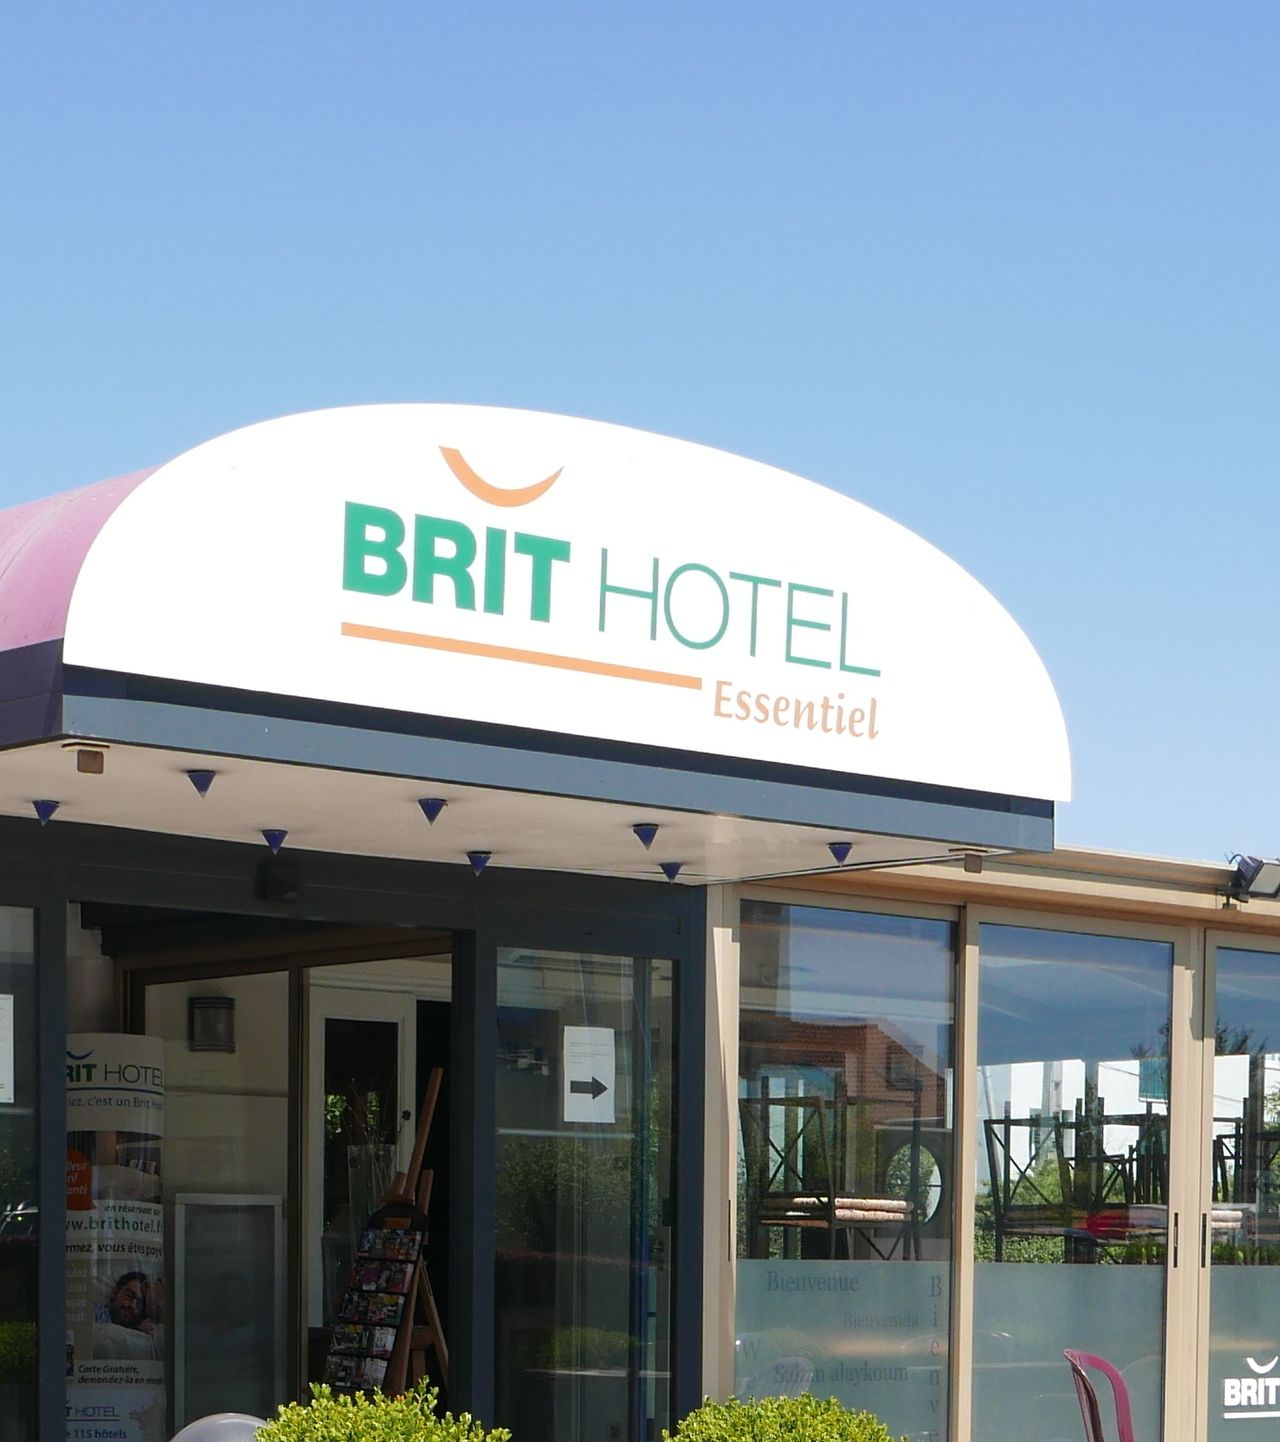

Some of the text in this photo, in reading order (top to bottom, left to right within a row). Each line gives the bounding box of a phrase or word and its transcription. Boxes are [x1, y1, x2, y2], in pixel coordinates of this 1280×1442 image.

[342, 501, 881, 678] BRIT HOTEL
[714, 680, 879, 740] Essentiel
[65, 1064, 97, 1082] RIT
[87, 1095, 113, 1107] c'est
[116, 1098, 130, 1107] un
[65, 1243, 94, 1254] rmez,
[98, 1244, 125, 1253] vous
[767, 1270, 859, 1292] Bienvenue
[842, 1310, 920, 1329] Bienvenida
[78, 1364, 101, 1374] Carte
[831, 1361, 908, 1386] alaykoum
[1224, 1378, 1280, 1407] BRIT
[75, 1406, 120, 1417] HOTEL
[74, 1428, 92, 1439] 115
[94, 1427, 127, 1439] hôtels
